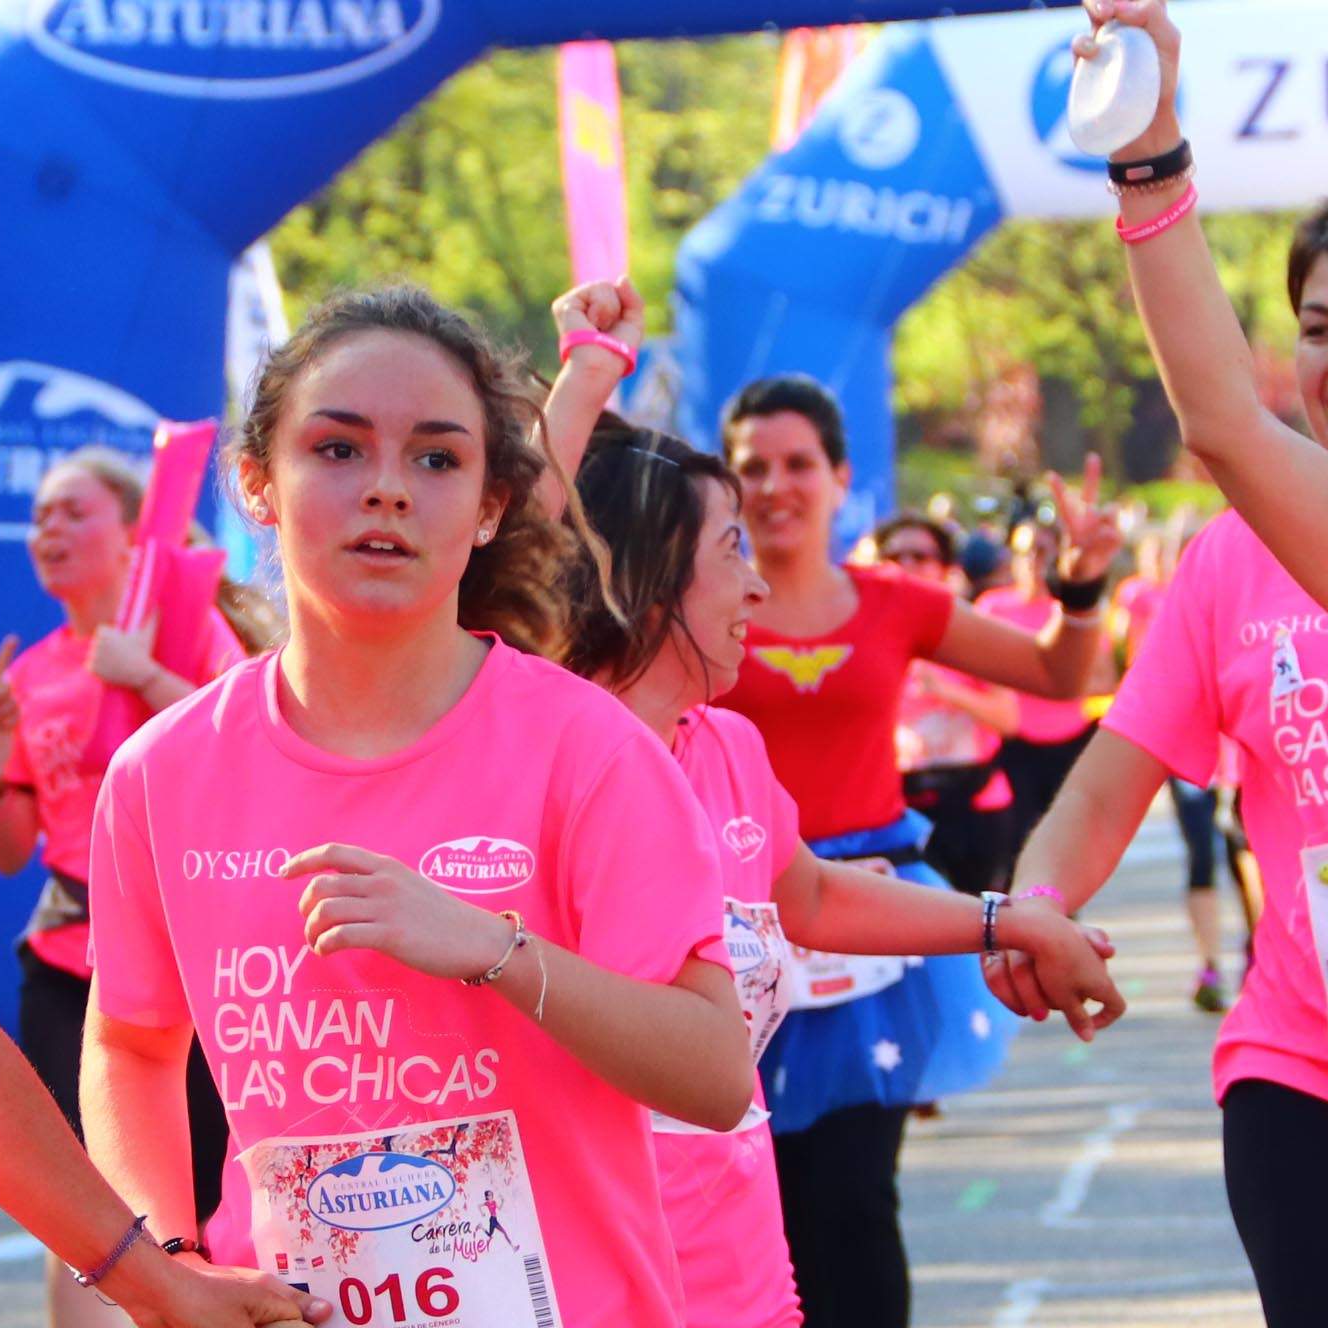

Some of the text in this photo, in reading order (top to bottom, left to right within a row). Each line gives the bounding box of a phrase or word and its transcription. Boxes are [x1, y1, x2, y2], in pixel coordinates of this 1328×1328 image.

[56, 0, 410, 48] ASTURIANA
[758, 174, 972, 244] ZURICH
[183, 848, 289, 881] OYSHO
[427, 854, 529, 879] ASTURIANA
[213, 945, 309, 998] HOY
[215, 999, 394, 1053] GANAN
[221, 1048, 500, 1111] LAS CHICAS
[318, 1180, 446, 1214] ASTURIANA
[411, 1221, 472, 1242] Carrera
[429, 1231, 493, 1262] de la Mujer
[339, 1267, 460, 1326] 016
